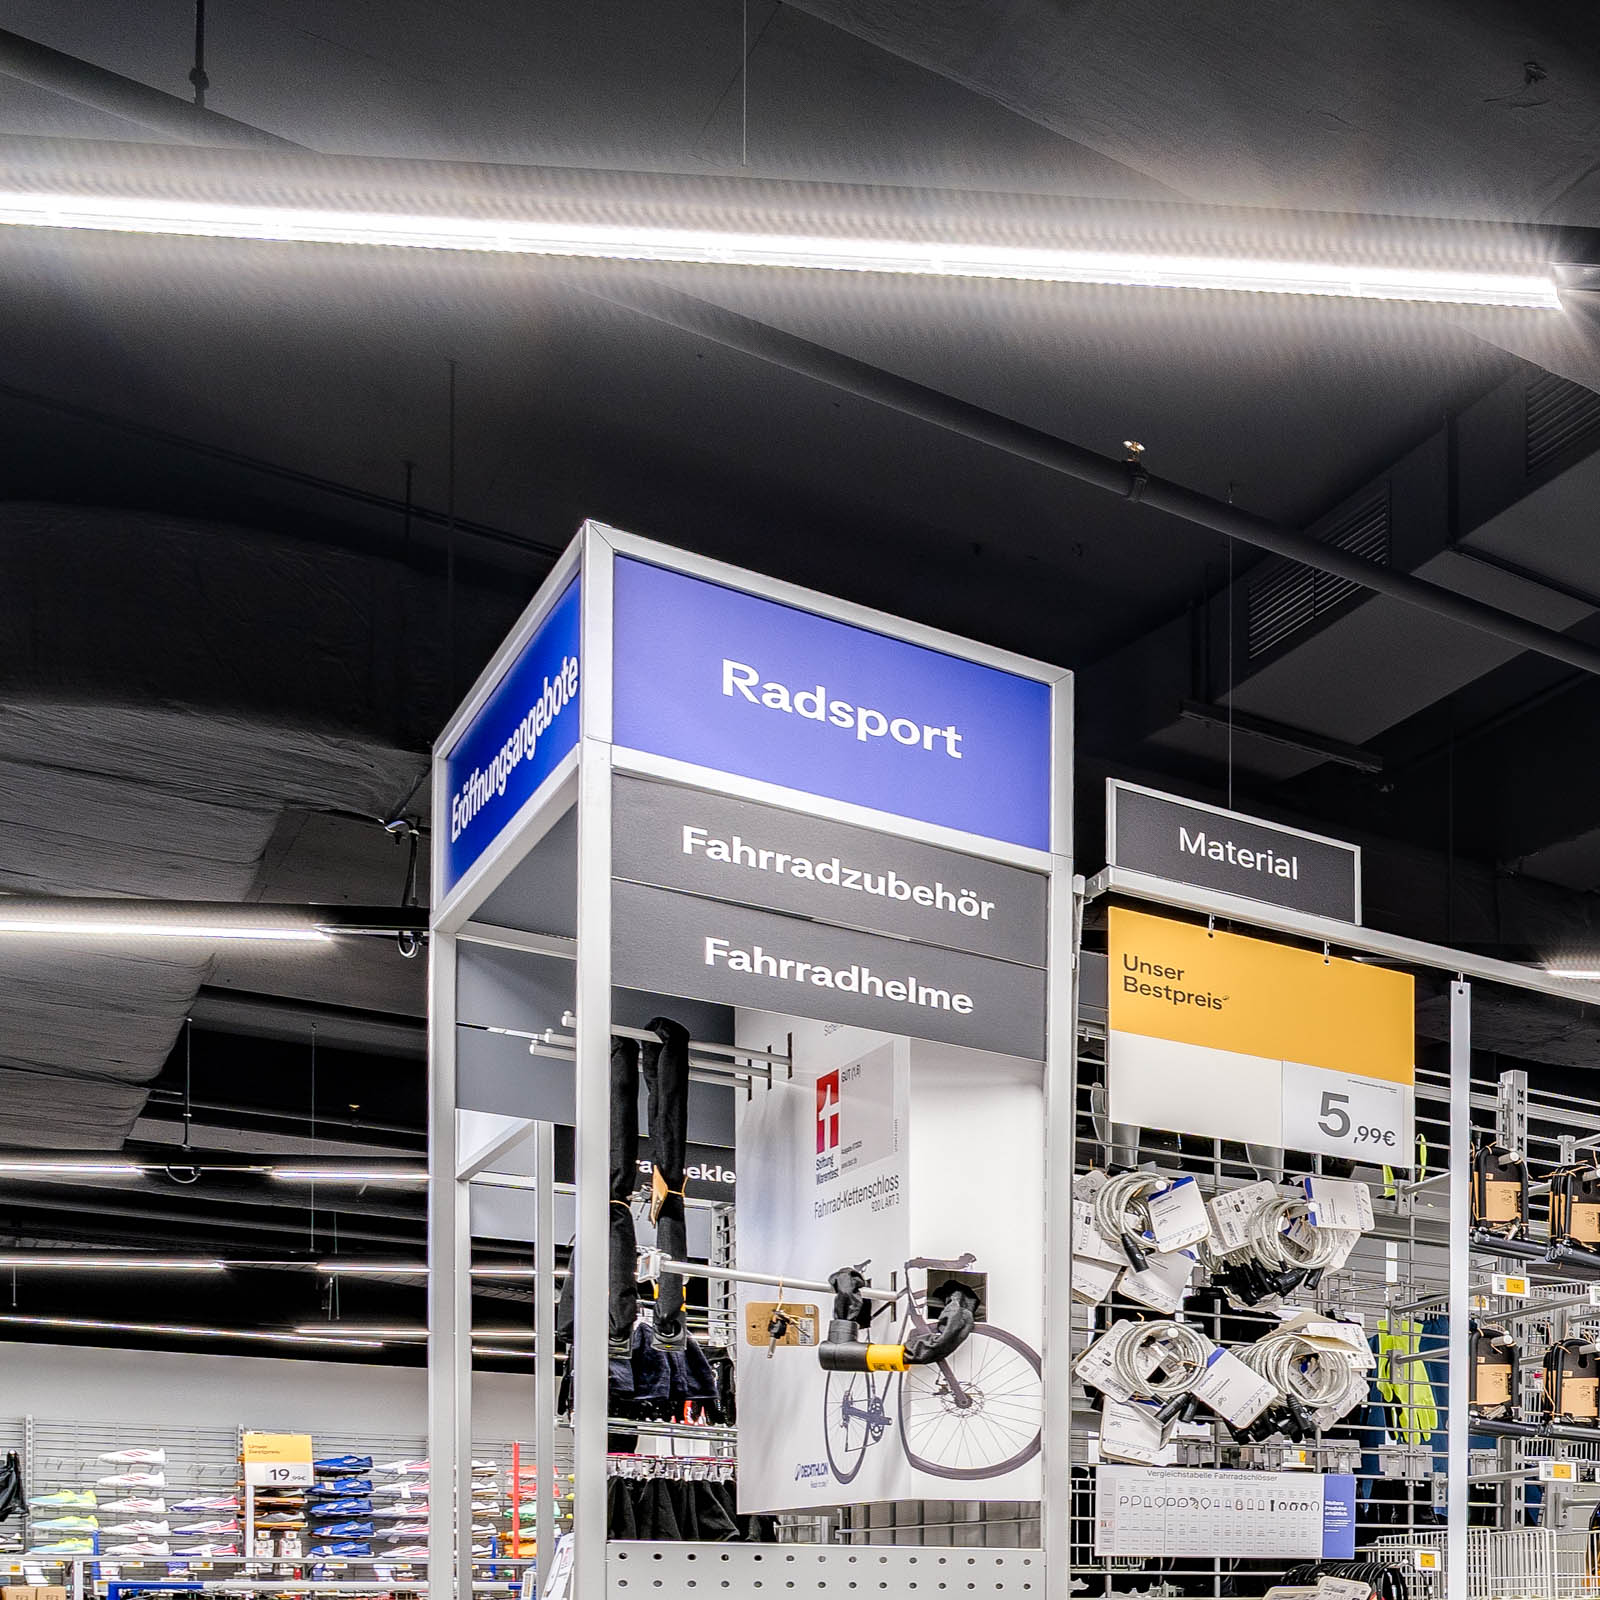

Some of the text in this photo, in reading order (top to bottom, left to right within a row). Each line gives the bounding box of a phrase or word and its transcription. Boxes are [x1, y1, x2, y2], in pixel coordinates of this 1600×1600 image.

[721, 658, 963, 759] Radsport
[450, 654, 579, 843] Eröffnungsangebote
[682, 825, 995, 921] Fahrradzubehör
[1178, 826, 1299, 881] Material
[703, 936, 975, 1014] Fahrradhelme
[1123, 953, 1185, 981] Unser
[1317, 1091, 1397, 1148] 5,99€
[814, 1174, 900, 1220] Fahrrad-Kettenschloss
[1147, 1470, 1213, 1480] Vergleichstabelle
